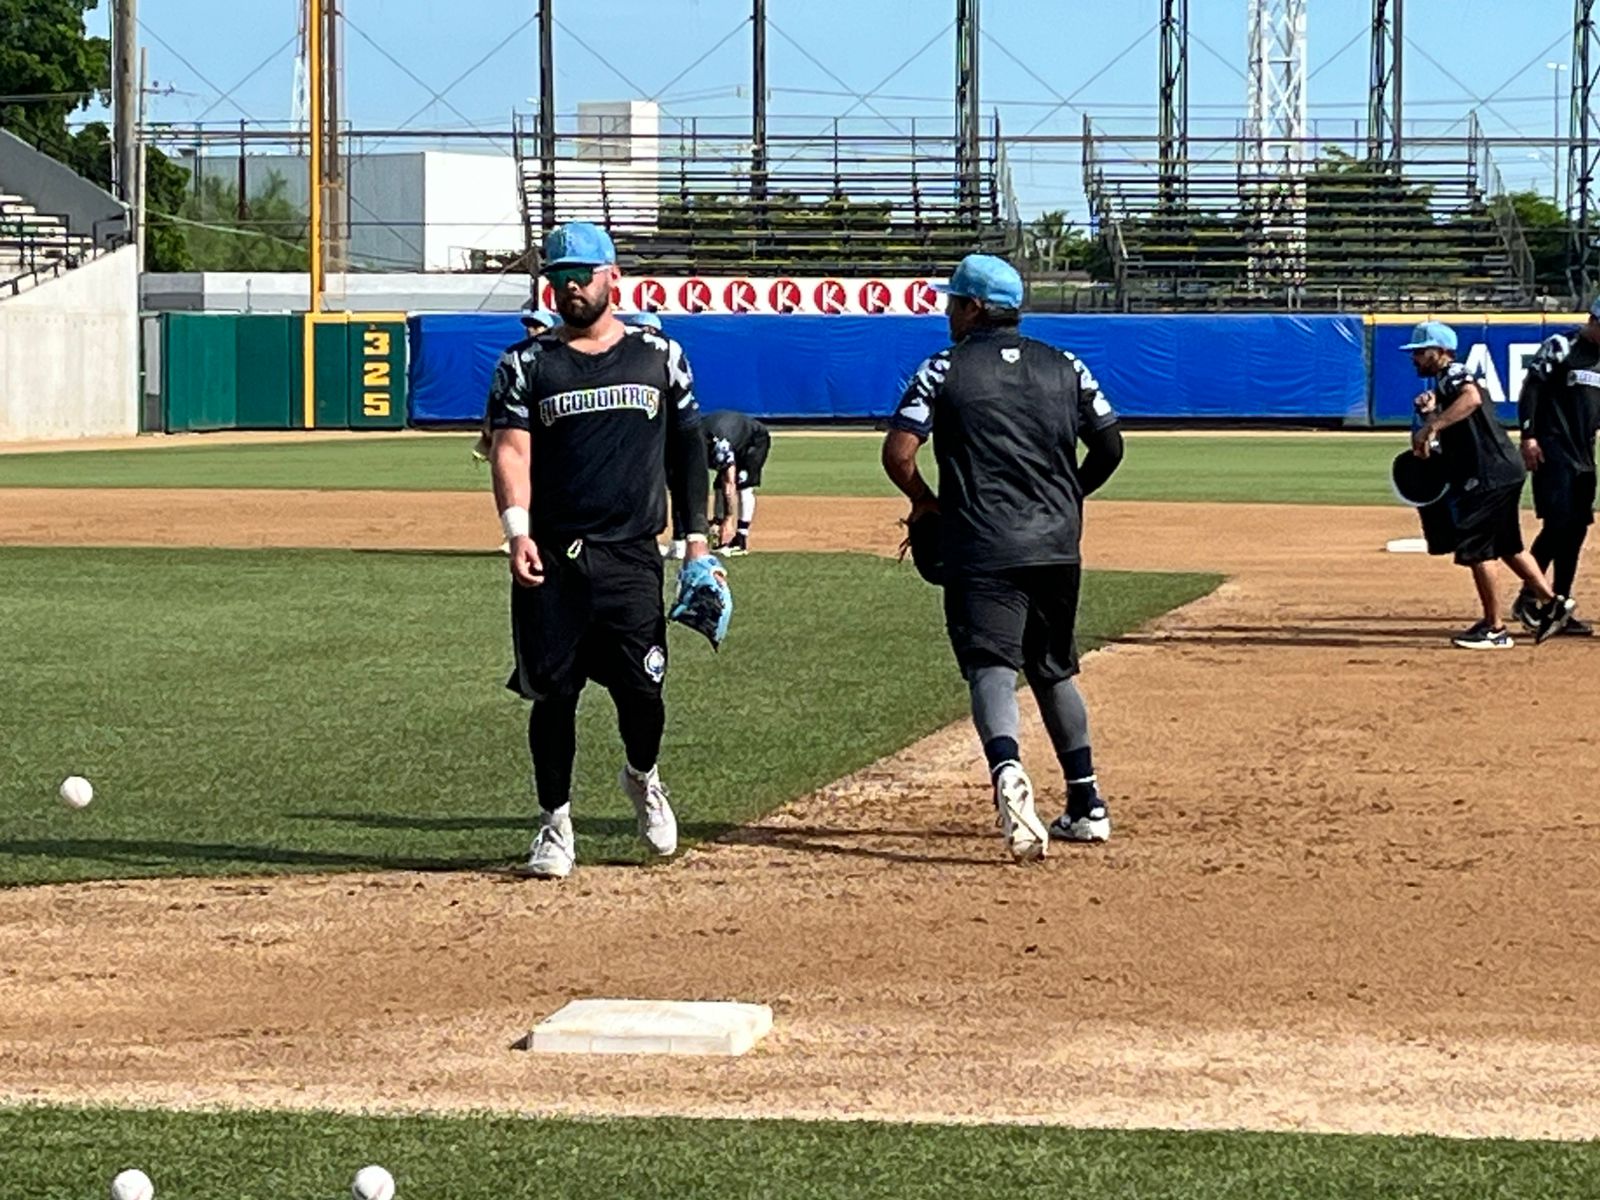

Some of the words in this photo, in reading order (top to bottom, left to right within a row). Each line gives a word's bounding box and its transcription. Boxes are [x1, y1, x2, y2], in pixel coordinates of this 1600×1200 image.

[641, 282, 665, 312] K
[687, 282, 711, 312] K
[732, 282, 756, 312] K
[777, 282, 801, 312] K
[822, 282, 846, 312] K
[867, 282, 891, 312] K
[912, 282, 937, 312] K
[363, 331, 390, 416] 325
